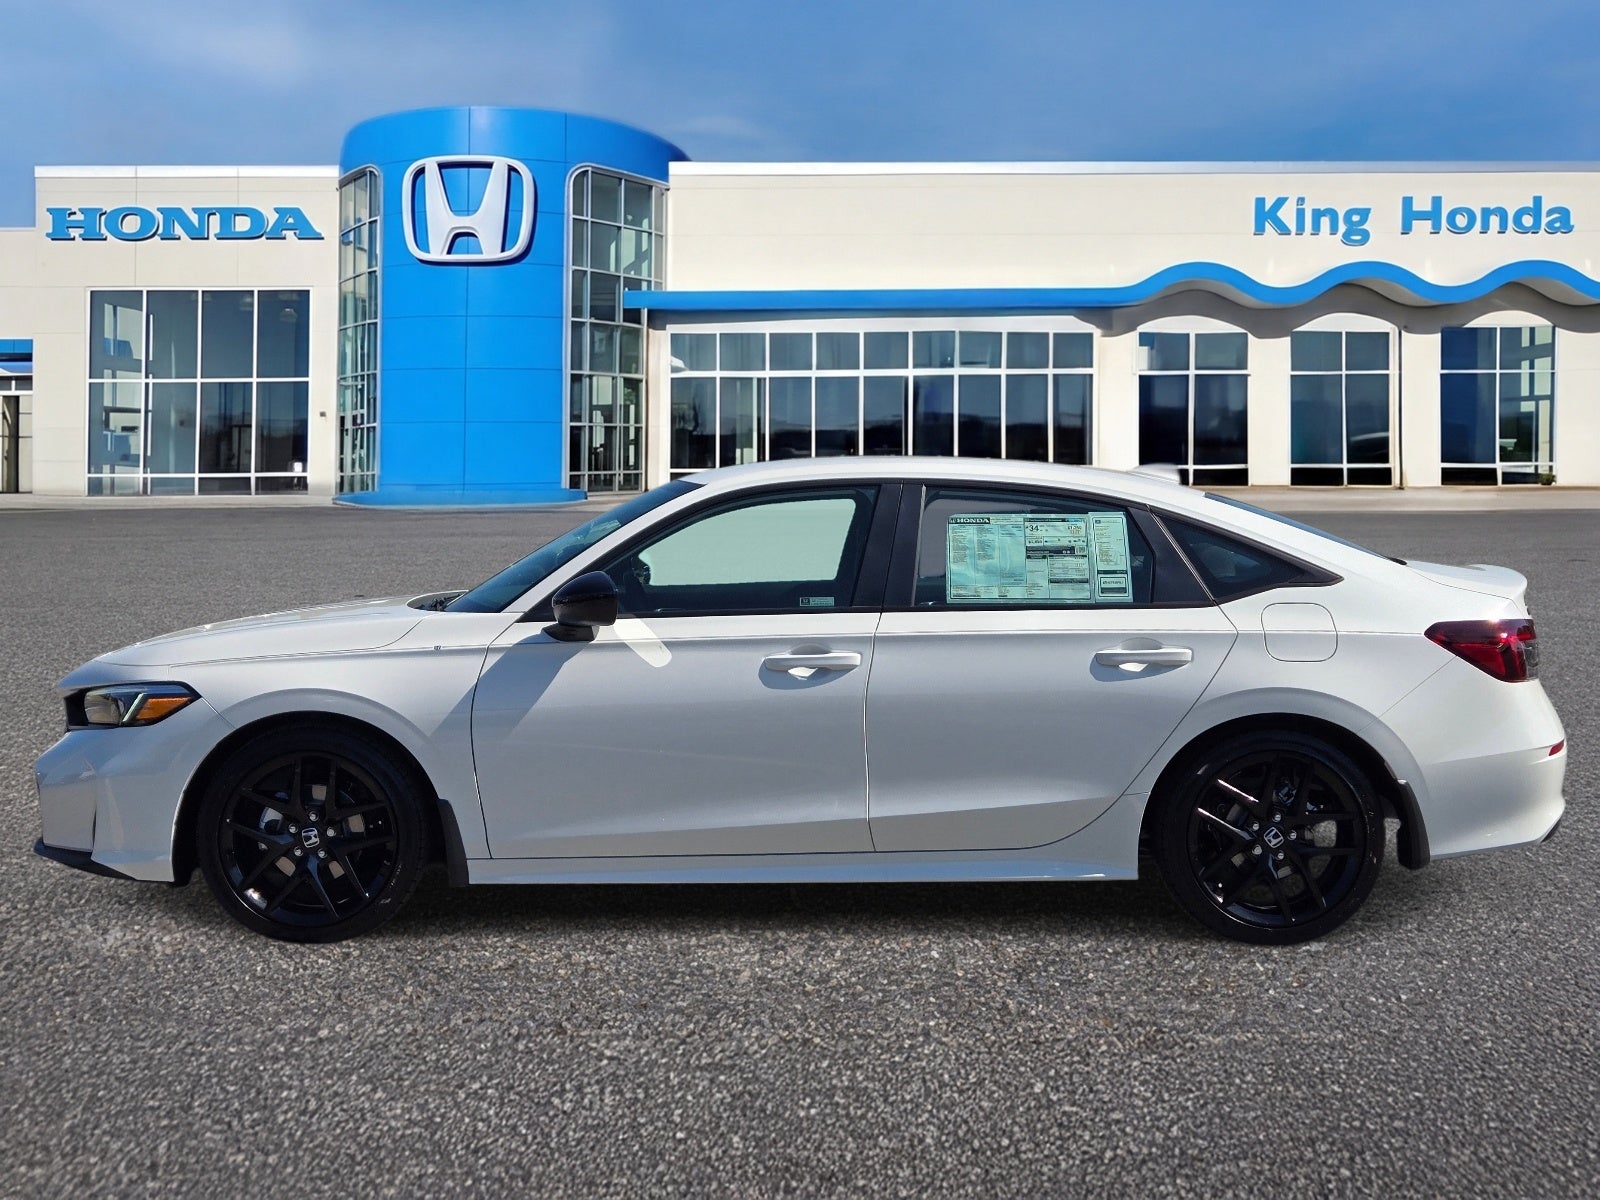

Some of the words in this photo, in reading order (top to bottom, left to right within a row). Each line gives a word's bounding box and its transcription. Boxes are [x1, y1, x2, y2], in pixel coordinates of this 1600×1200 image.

[45, 206, 325, 241] HONDA
[1252, 196, 1372, 247] King
[1400, 195, 1575, 235] Honda
[1028, 524, 1040, 532] 34
